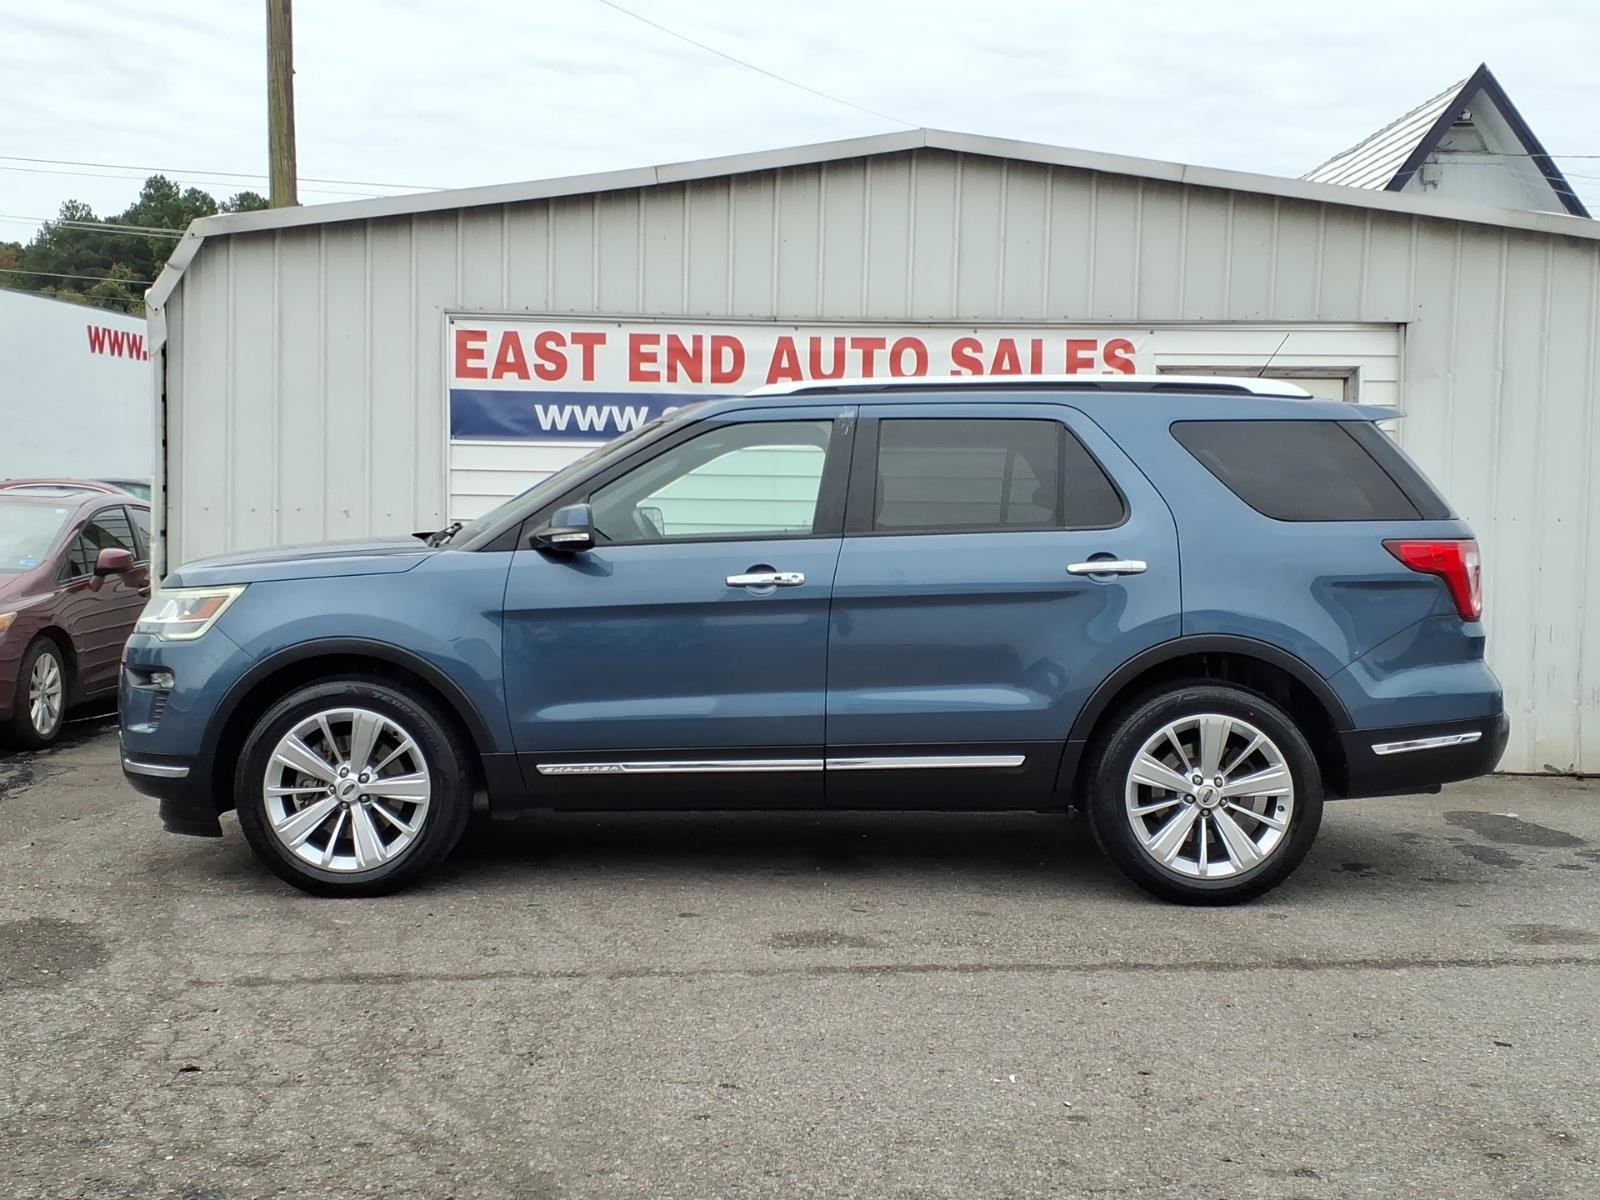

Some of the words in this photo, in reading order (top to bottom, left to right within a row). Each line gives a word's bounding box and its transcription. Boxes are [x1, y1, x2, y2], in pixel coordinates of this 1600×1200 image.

[455, 330, 607, 382] EAST
[628, 333, 746, 385] END
[766, 336, 929, 385] AUTO
